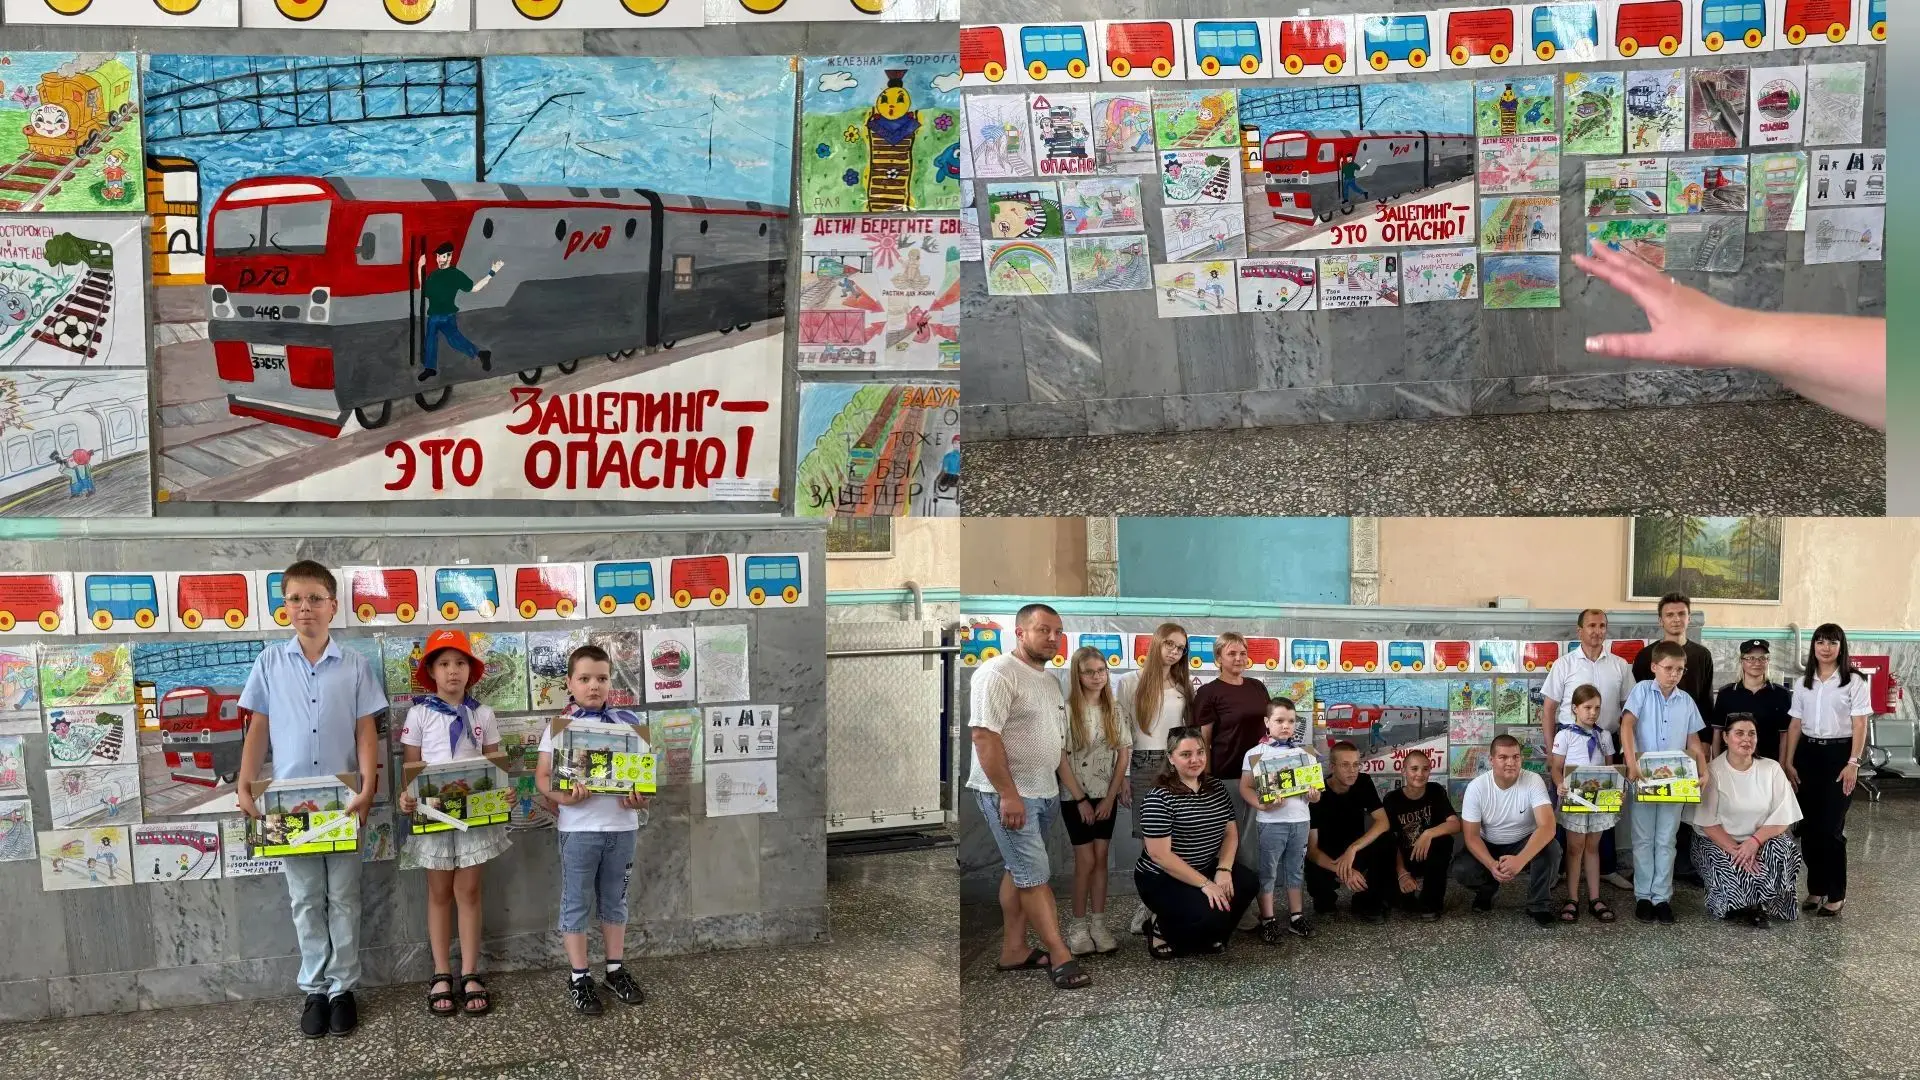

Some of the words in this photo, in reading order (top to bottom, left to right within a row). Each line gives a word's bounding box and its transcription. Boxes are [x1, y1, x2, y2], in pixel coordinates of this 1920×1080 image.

[827, 56, 883, 67] ЖЕЛЕЗНАЯ
[904, 54, 957, 65] ДОРОГА
[1040, 157, 1096, 174] ОПАСНО
[813, 218, 856, 236] ДЕТИ!
[861, 217, 933, 235] БЕРЕГИТЕ
[1330, 223, 1368, 245] ЭТО
[1381, 214, 1466, 243] ОПАСНО!
[0, 246, 47, 260] МАТЕЛЕ
[255, 305, 281, 320] 448
[890, 430, 944, 447] ТОЖЕ
[384, 437, 483, 491] ЭТО
[524, 425, 754, 490] ОПАСНО!
[876, 458, 925, 480] БЫЛ
[1363, 760, 1385, 772] ЭТО
